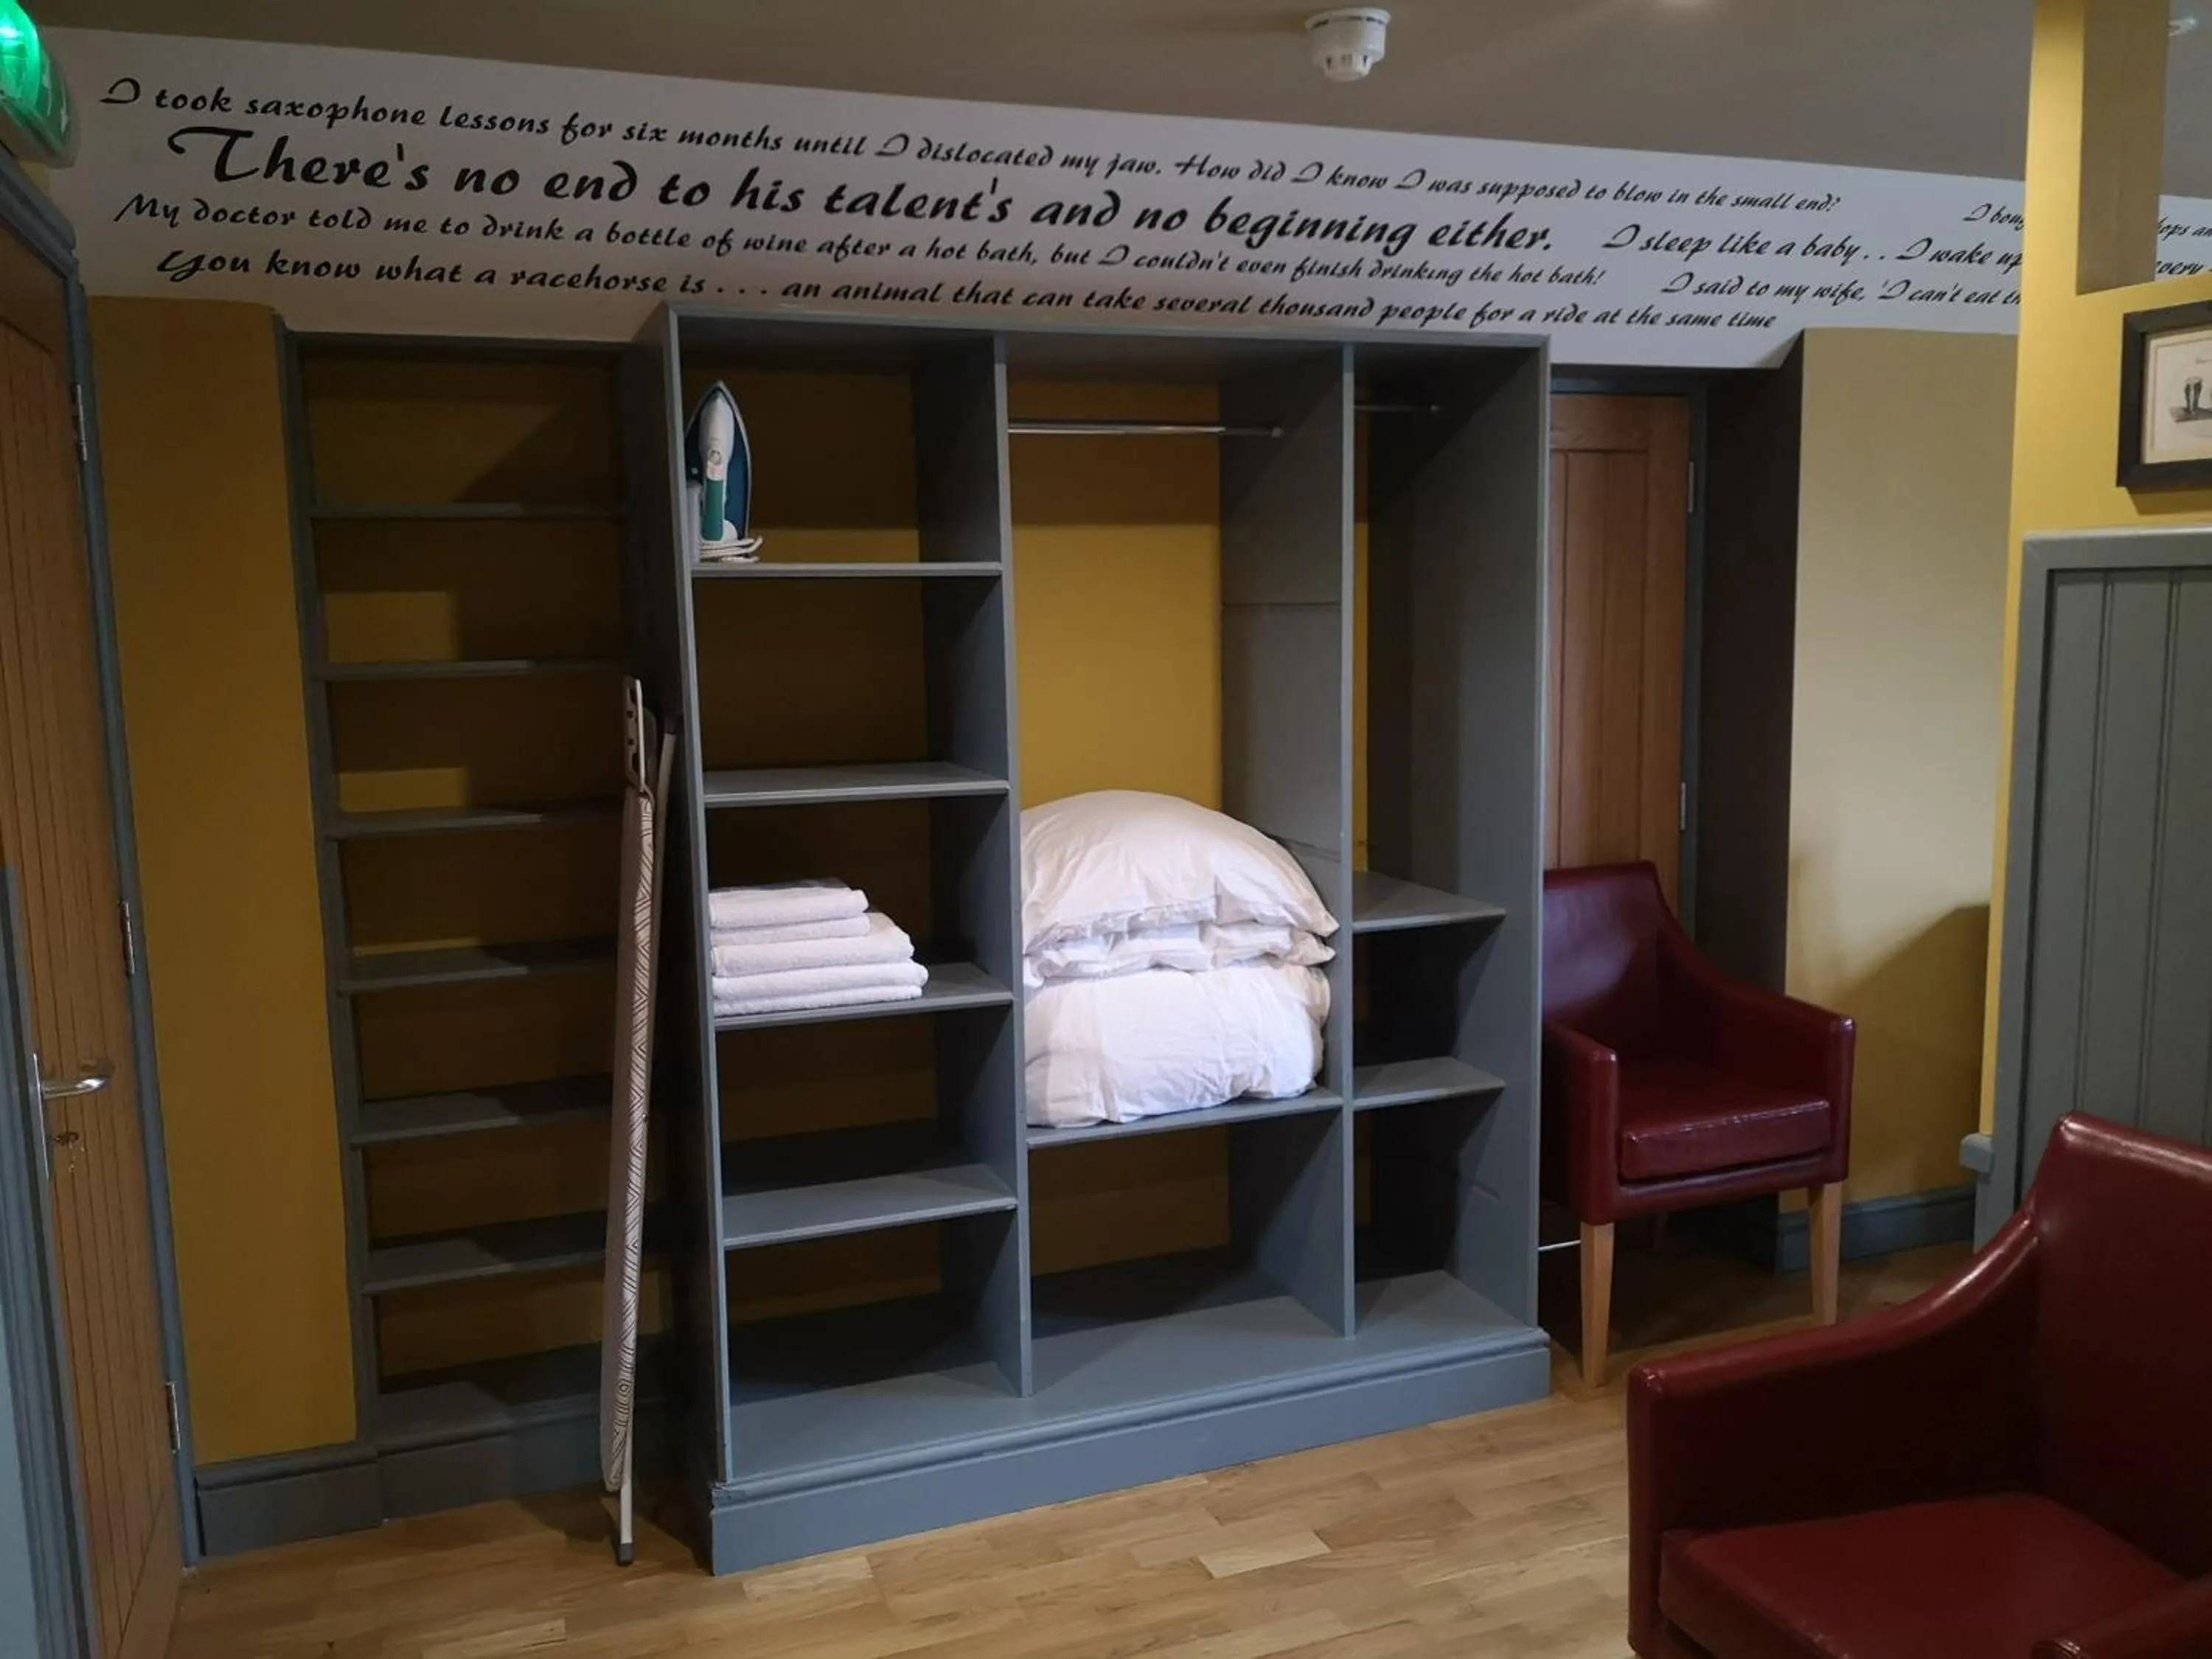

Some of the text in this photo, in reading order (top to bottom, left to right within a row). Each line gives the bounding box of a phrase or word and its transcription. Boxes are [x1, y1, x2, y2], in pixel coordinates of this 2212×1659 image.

[99, 77, 1841, 212] I took saxophone lessons for six months until I dislocated my jaw. How did I know I was supposed to blow in the small end?
[167, 125, 1551, 256] There's no end to his talent's and no beginning either.
[1963, 203, 1993, 222] I
[113, 192, 1606, 288] My doctor told me to drink a bottle of wine after a hot bath, but I couldn't even finish drinking the hot bath!
[1601, 223, 1641, 248] I
[1638, 230, 1712, 262] sleep
[1717, 231, 1772, 255] like
[1775, 241, 1796, 256] a
[1895, 237, 1933, 260] I
[1928, 242, 1994, 265] wake
[156, 249, 250, 283] You
[264, 248, 361, 279] know
[375, 254, 462, 283] what
[473, 268, 497, 285] a
[509, 263, 667, 293] racehorse
[679, 274, 706, 295] is
[780, 282, 821, 299] an
[830, 282, 945, 303] animal
[952, 279, 1015, 306] that
[1021, 292, 1074, 307] can
[1082, 286, 1147, 310] take
[1152, 295, 1253, 314] several
[1258, 293, 1375, 318] thousand
[1375, 302, 1468, 328] people
[1468, 301, 1515, 330] for
[1517, 309, 1537, 322] a
[1541, 302, 1588, 324] ride
[1592, 308, 1622, 324] at
[1626, 304, 1662, 326] the
[1665, 313, 1723, 327] same
[1727, 311, 1777, 328] time
[1660, 271, 1694, 293] I
[1692, 275, 1745, 296] said
[1745, 280, 1770, 296] to
[1773, 285, 1810, 305] my
[1907, 282, 1964, 303] can't
[1963, 290, 2002, 305] eat
